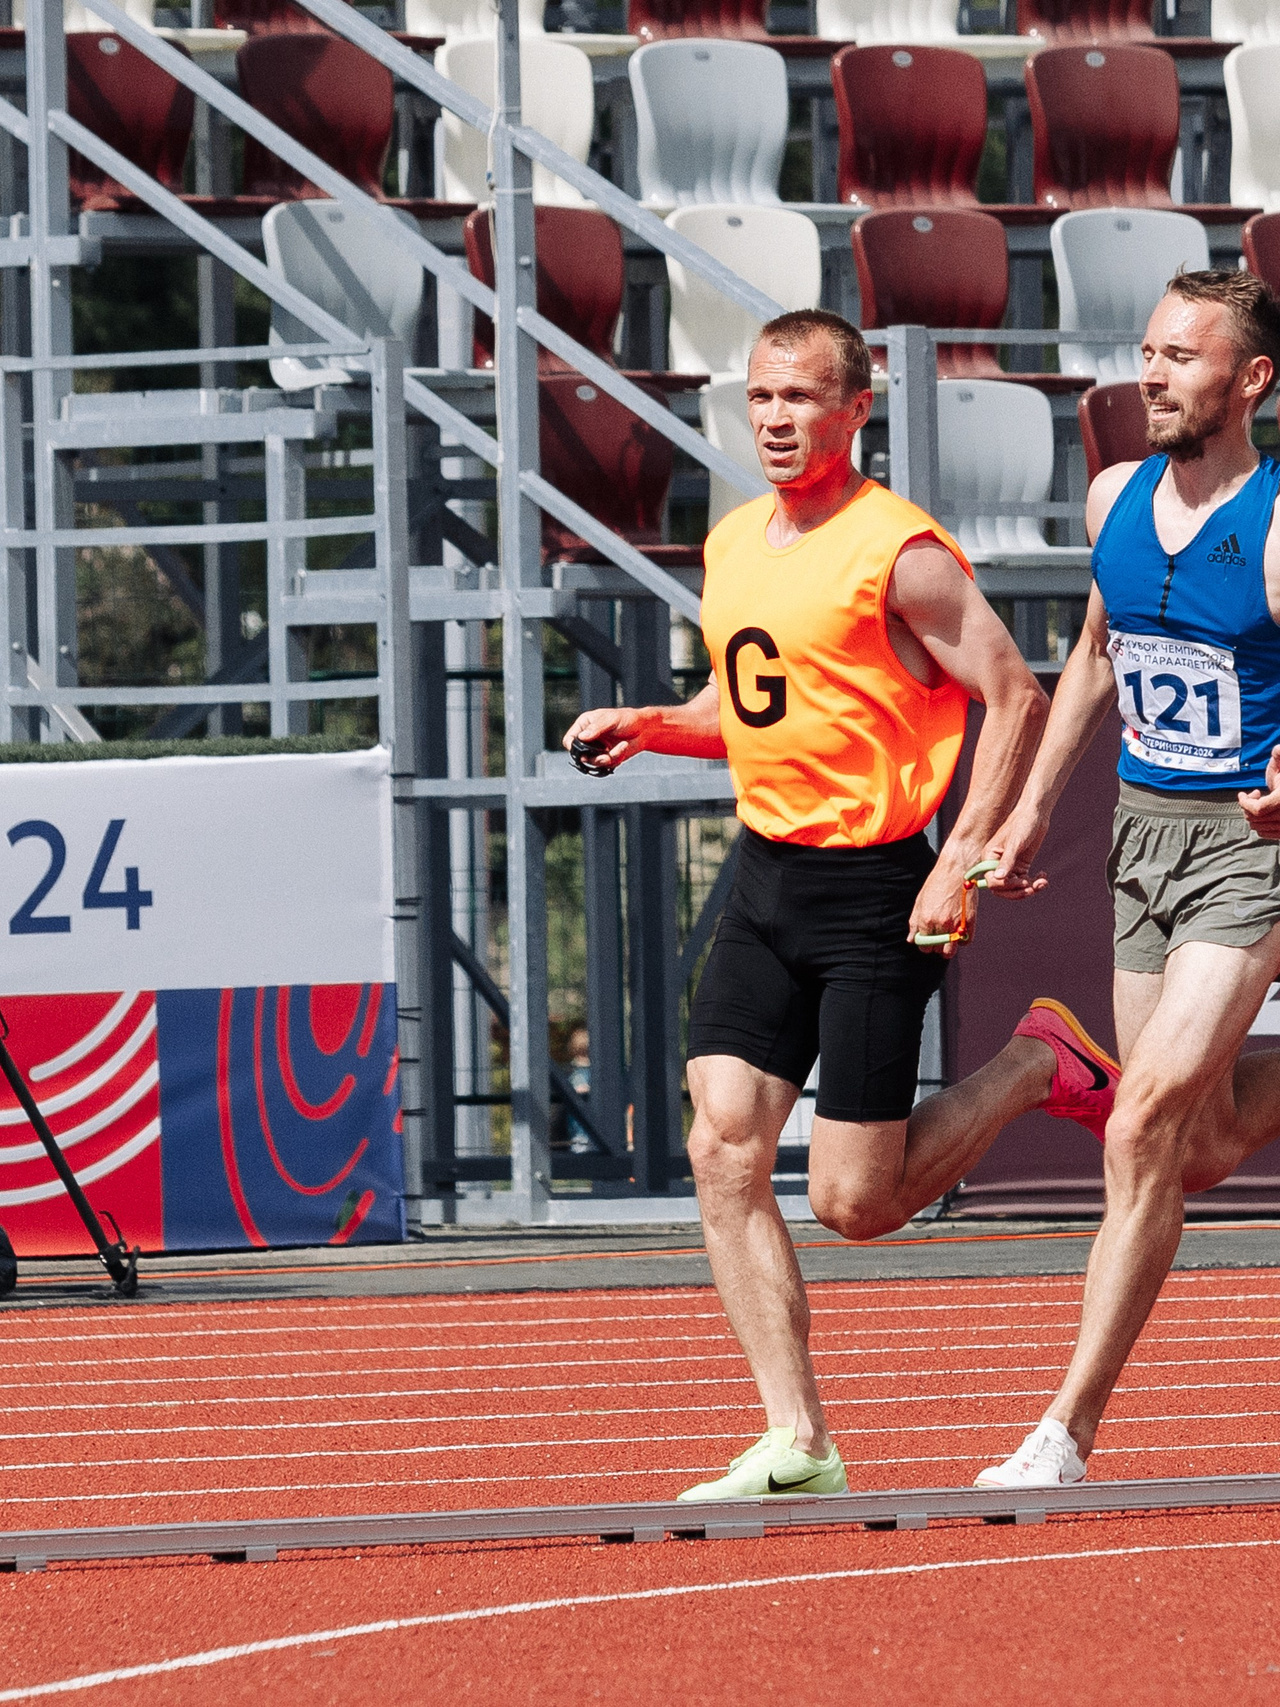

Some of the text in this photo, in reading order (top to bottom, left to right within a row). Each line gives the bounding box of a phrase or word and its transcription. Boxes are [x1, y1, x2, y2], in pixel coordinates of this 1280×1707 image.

[1206, 551, 1247, 567] adidas
[1126, 639, 1227, 664] КУБОК ЧЕМПИООВ
[1127, 650, 1141, 662] ПО
[725, 626, 787, 729] G
[1123, 669, 1222, 737] 121
[1139, 734, 1215, 758] ТЕРИНБУРГ 2024
